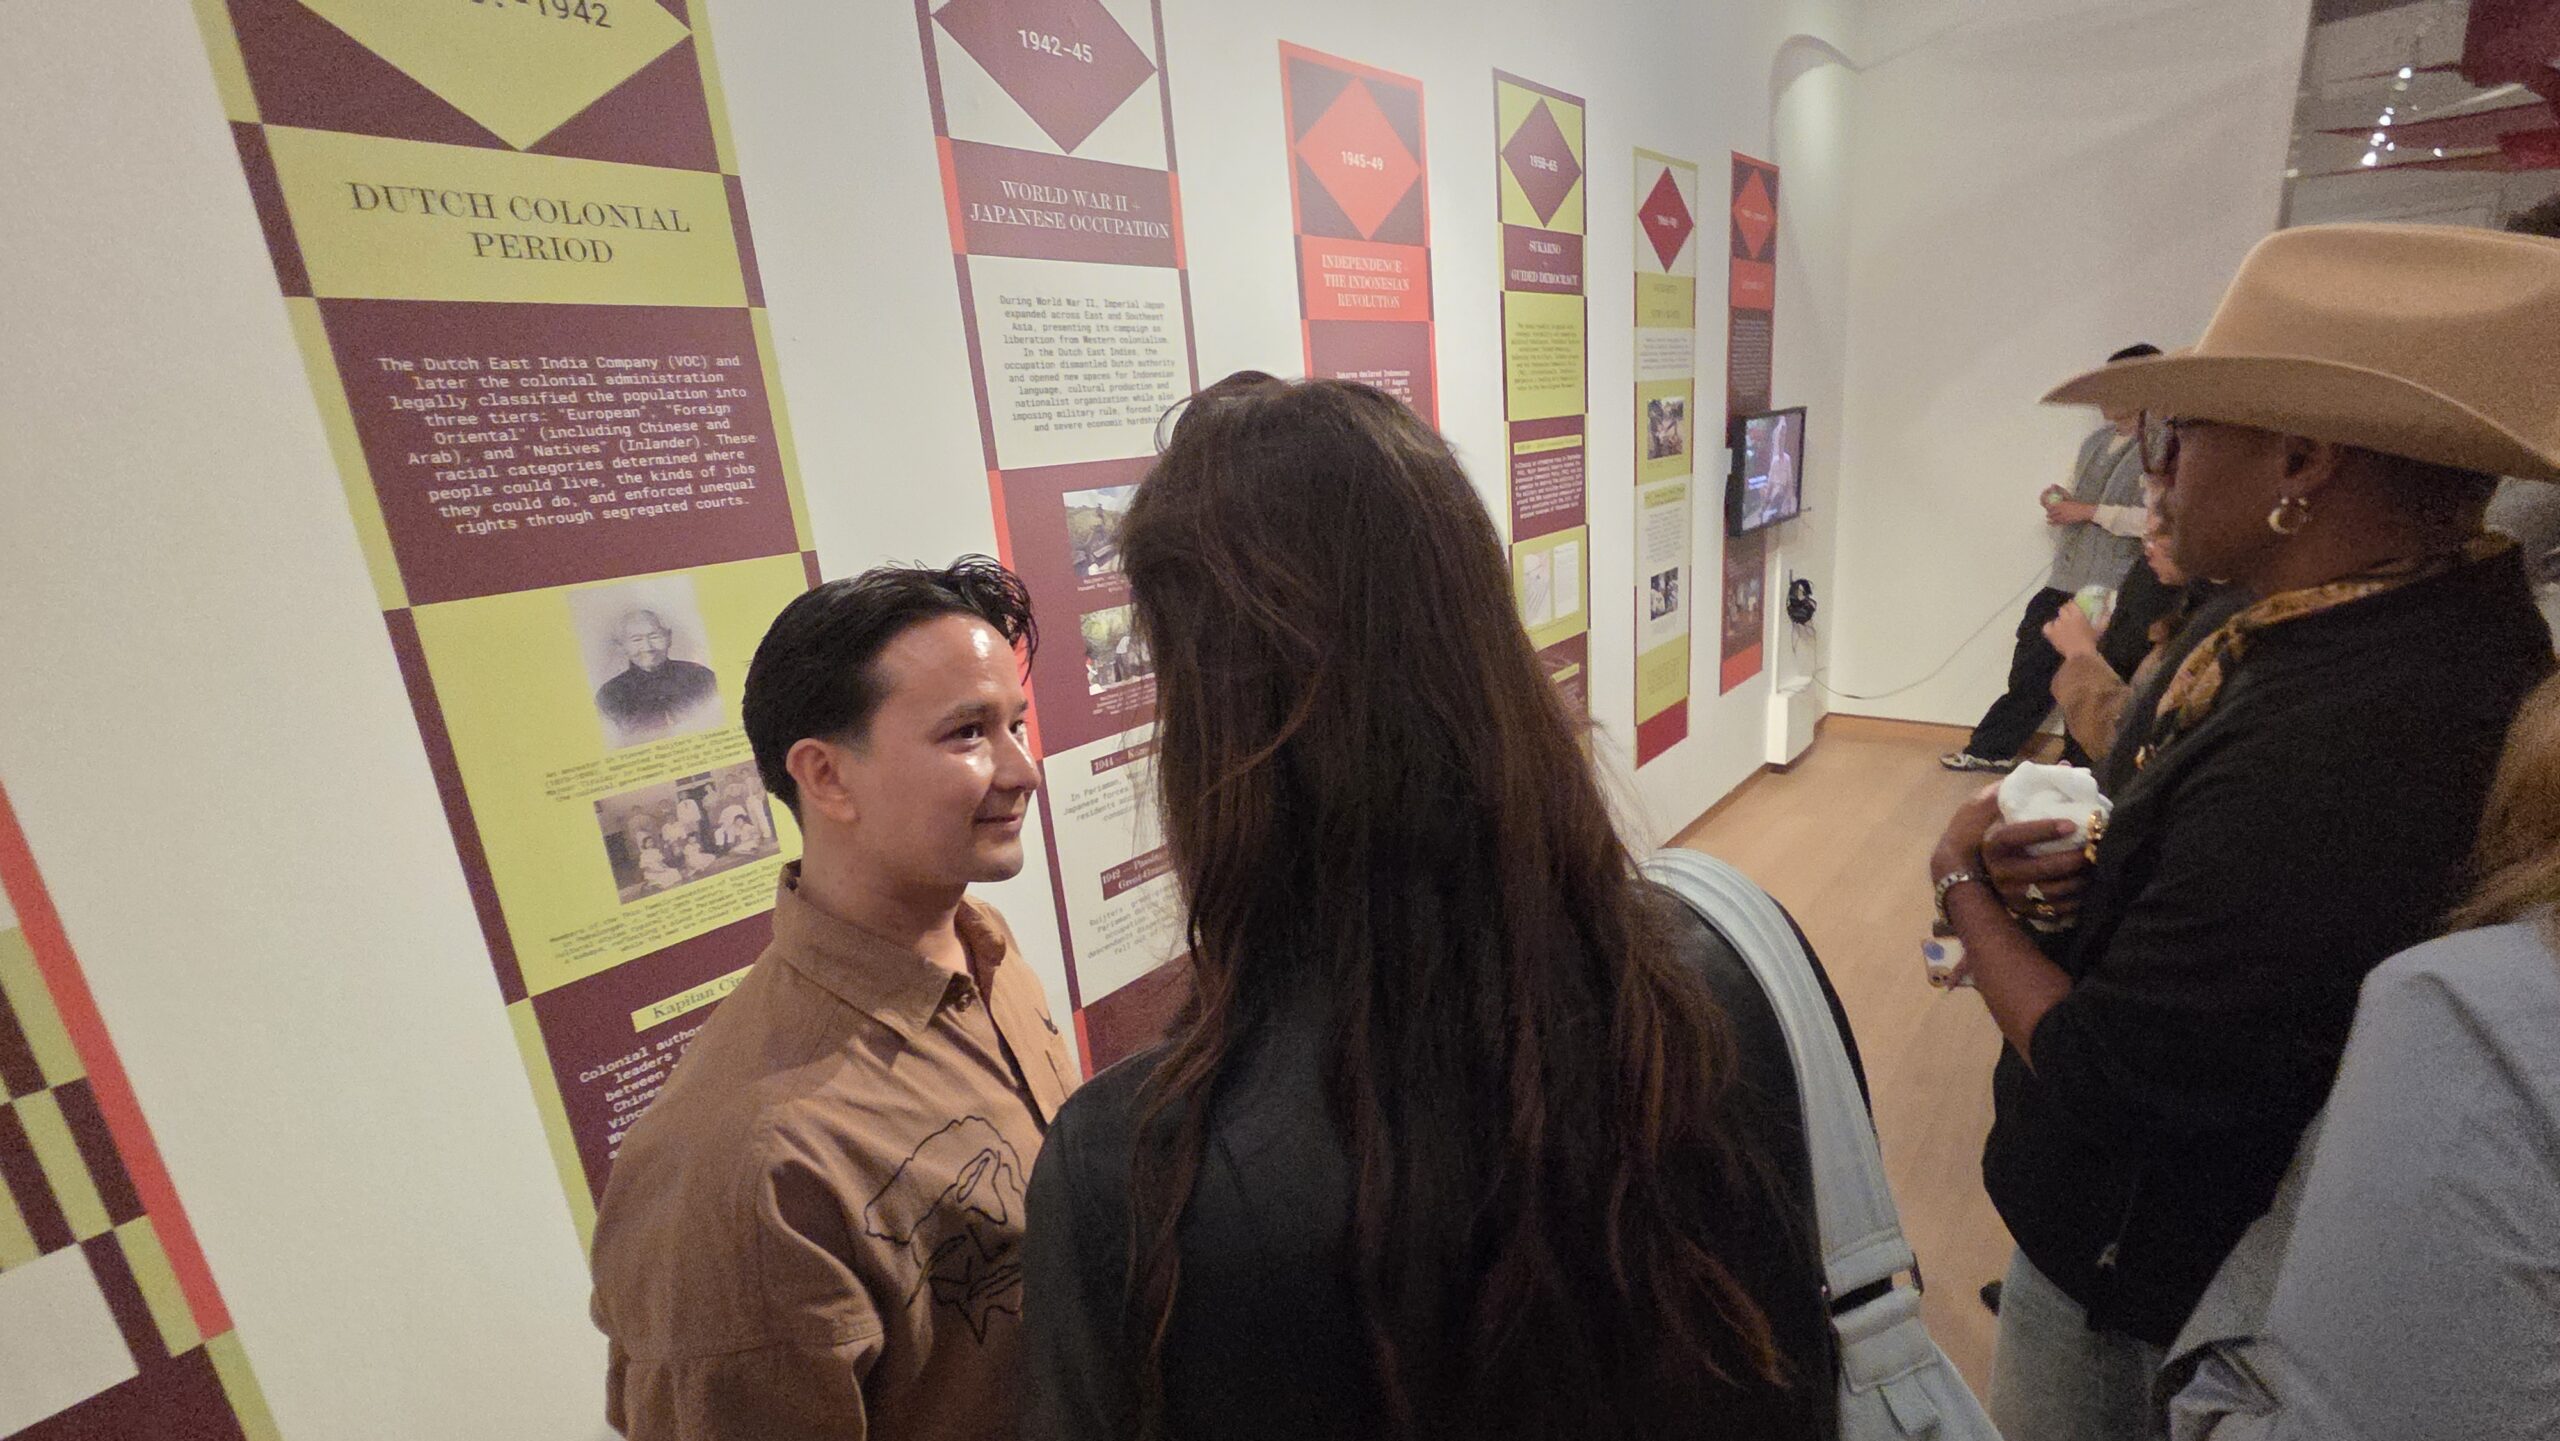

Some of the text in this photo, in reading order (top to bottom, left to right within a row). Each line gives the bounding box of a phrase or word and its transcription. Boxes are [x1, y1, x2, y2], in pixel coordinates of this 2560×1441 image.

[344, 182, 691, 233] DUTCH COLONIAL
[1000, 180, 1068, 206] WORLD
[1072, 190, 1112, 211] WAR
[1114, 195, 1129, 212] II
[970, 203, 1170, 240] JAPANESE OCCUPATION
[467, 232, 613, 263] PERIOD
[1321, 254, 1403, 273] INDEPENDENCE
[1324, 273, 1410, 291] THE INDONESIAN
[1337, 293, 1400, 309] REVOLUTION
[378, 355, 740, 371] The Dutch East India Company (VOC) and
[412, 372, 724, 390] later the colonial administration
[390, 388, 747, 410] legally classified the population into
[424, 413, 479, 427] three
[540, 423, 631, 441] (including
[639, 421, 699, 434] Chinese
[706, 418, 731, 430] and
[483, 447, 515, 460] and
[715, 434, 757, 445] These
[435, 450, 745, 481] racial categories determined where
[429, 484, 493, 503] people
[503, 479, 553, 494] could
[616, 473, 643, 485] the
[650, 468, 693, 481] kinds
[700, 465, 717, 478] of
[724, 463, 756, 477] jobs
[439, 504, 482, 518] they
[492, 498, 543, 513] could
[589, 490, 616, 504] and
[624, 483, 693, 501] enforced
[700, 478, 756, 493] unequal
[456, 518, 518, 535] rights
[526, 510, 593, 527] through
[602, 500, 688, 519] segregated
[653, 988, 715, 1019] Kapitan
[579, 1046, 650, 1083] Colonial
[614, 1052, 673, 1084] leaders
[605, 1070, 664, 1102] between
